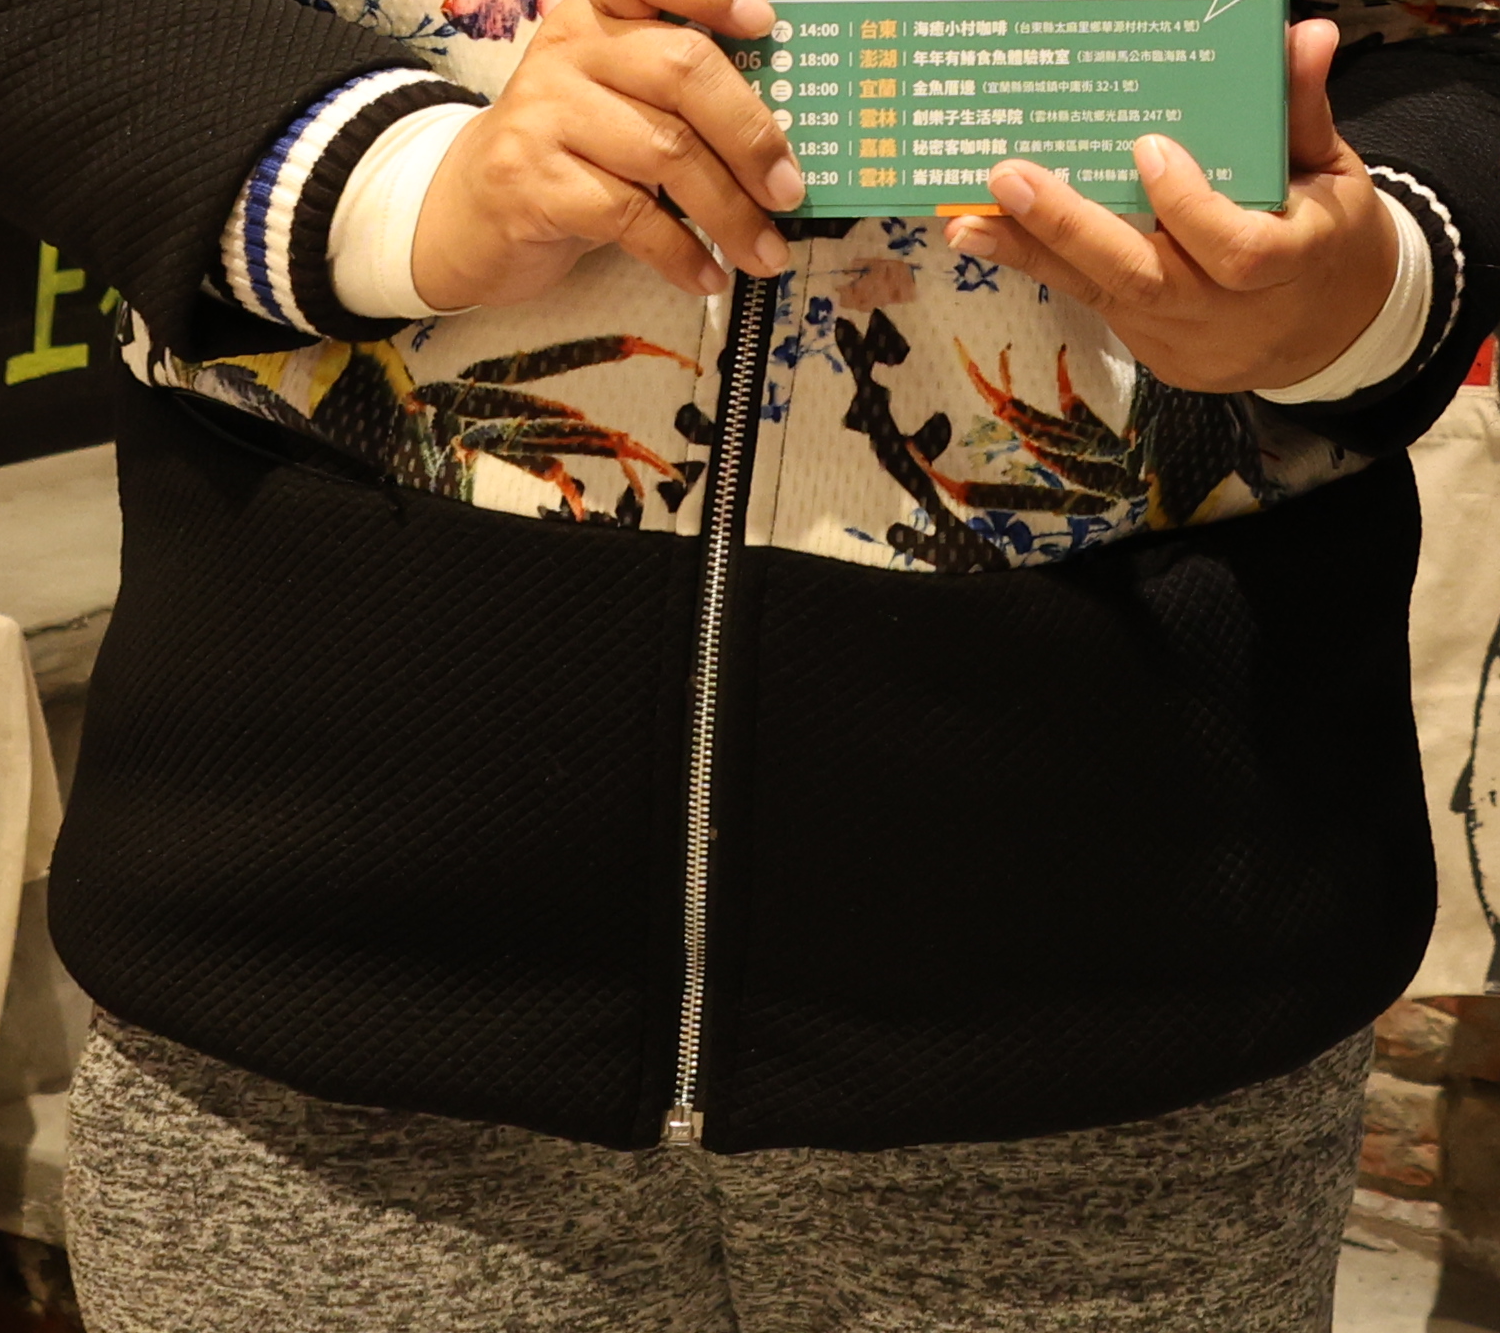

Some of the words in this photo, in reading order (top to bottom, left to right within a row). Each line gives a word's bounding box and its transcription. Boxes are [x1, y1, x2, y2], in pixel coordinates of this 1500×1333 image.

[799, 23, 839, 38] 14:00
[859, 19, 897, 40] 台東
[798, 52, 839, 67] 18:00
[859, 49, 897, 69] 澎湖
[798, 83, 839, 97] 18:00
[858, 78, 897, 99] 宜蘭
[798, 112, 839, 127] 18:30
[858, 108, 897, 129] 雲林
[798, 141, 839, 156] 18:30
[858, 137, 897, 159] 嘉義
[911, 138, 1008, 156] 秘密客咖啡館
[858, 167, 897, 188] 雲林
